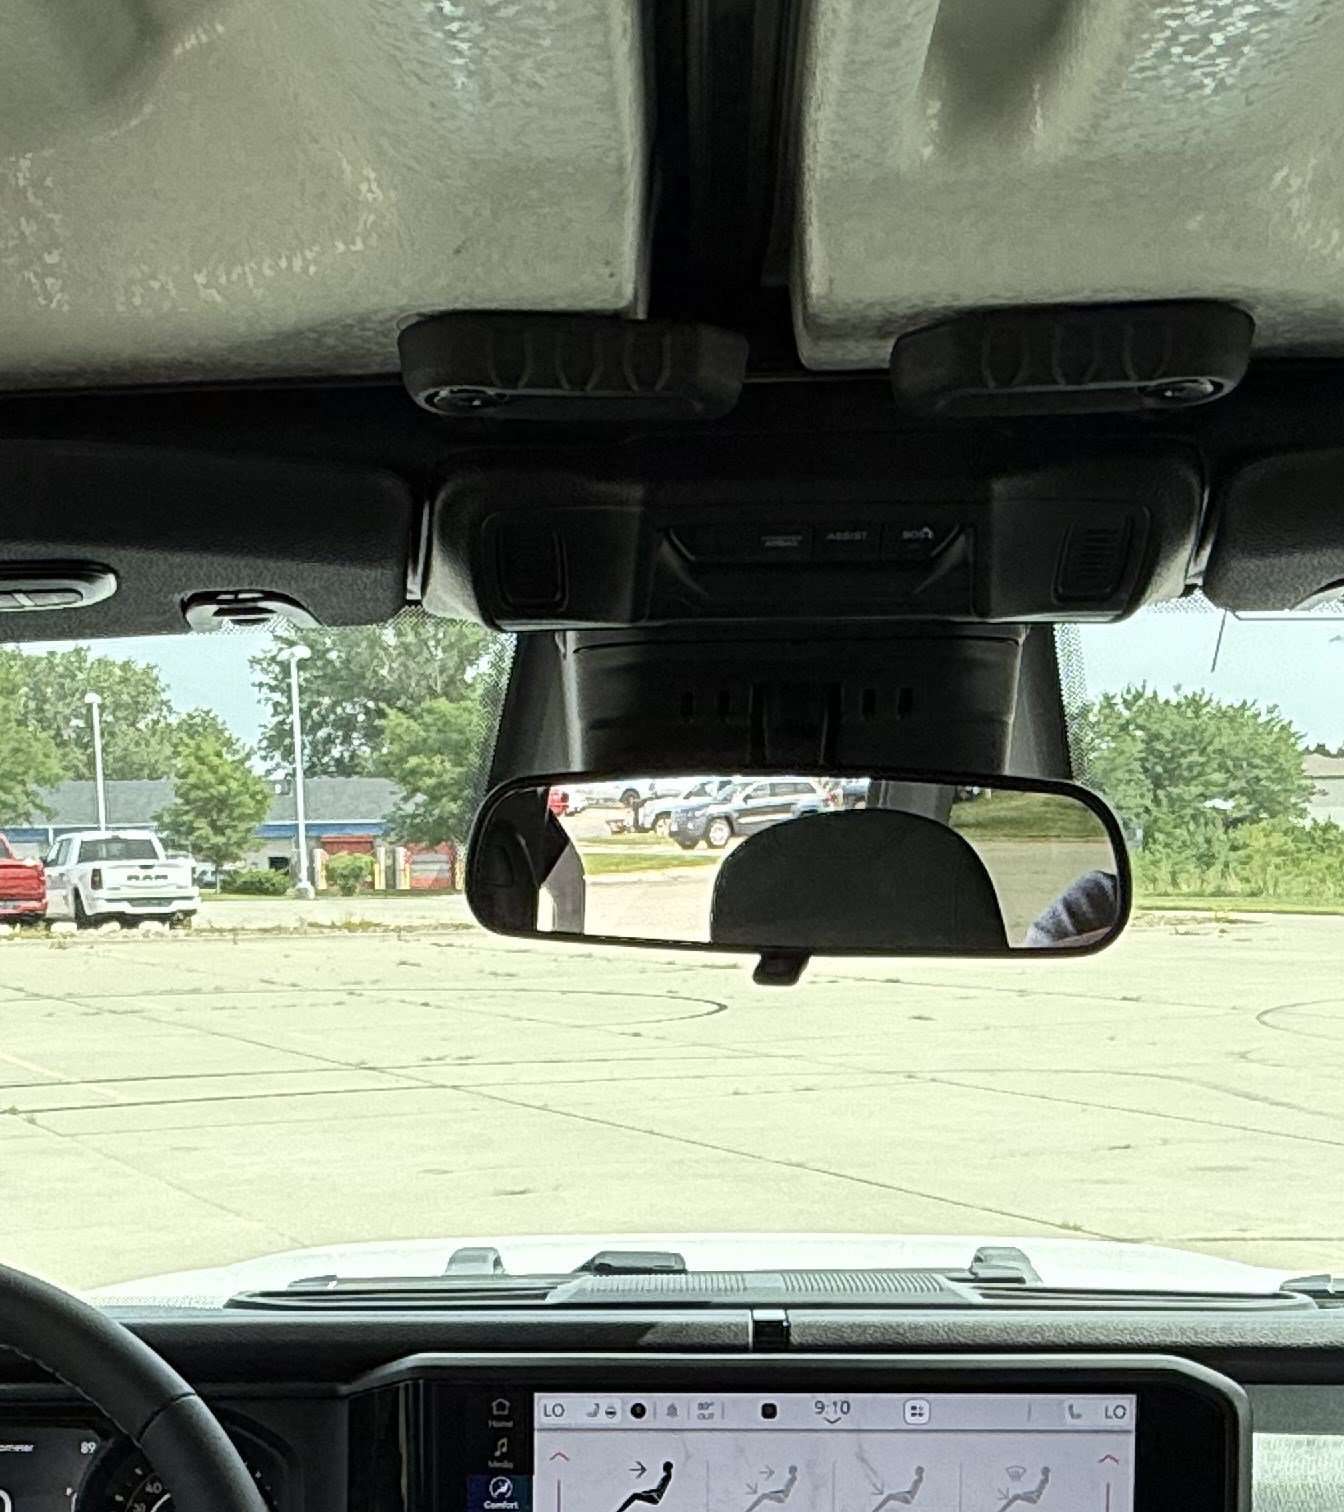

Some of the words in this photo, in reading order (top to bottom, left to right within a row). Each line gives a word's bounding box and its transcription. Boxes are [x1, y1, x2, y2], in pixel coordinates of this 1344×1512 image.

[543, 1404, 565, 1418] LO
[814, 1400, 851, 1415] 9:10
[1104, 1405, 1127, 1419] LO
[483, 1501, 519, 1510] Comfort
